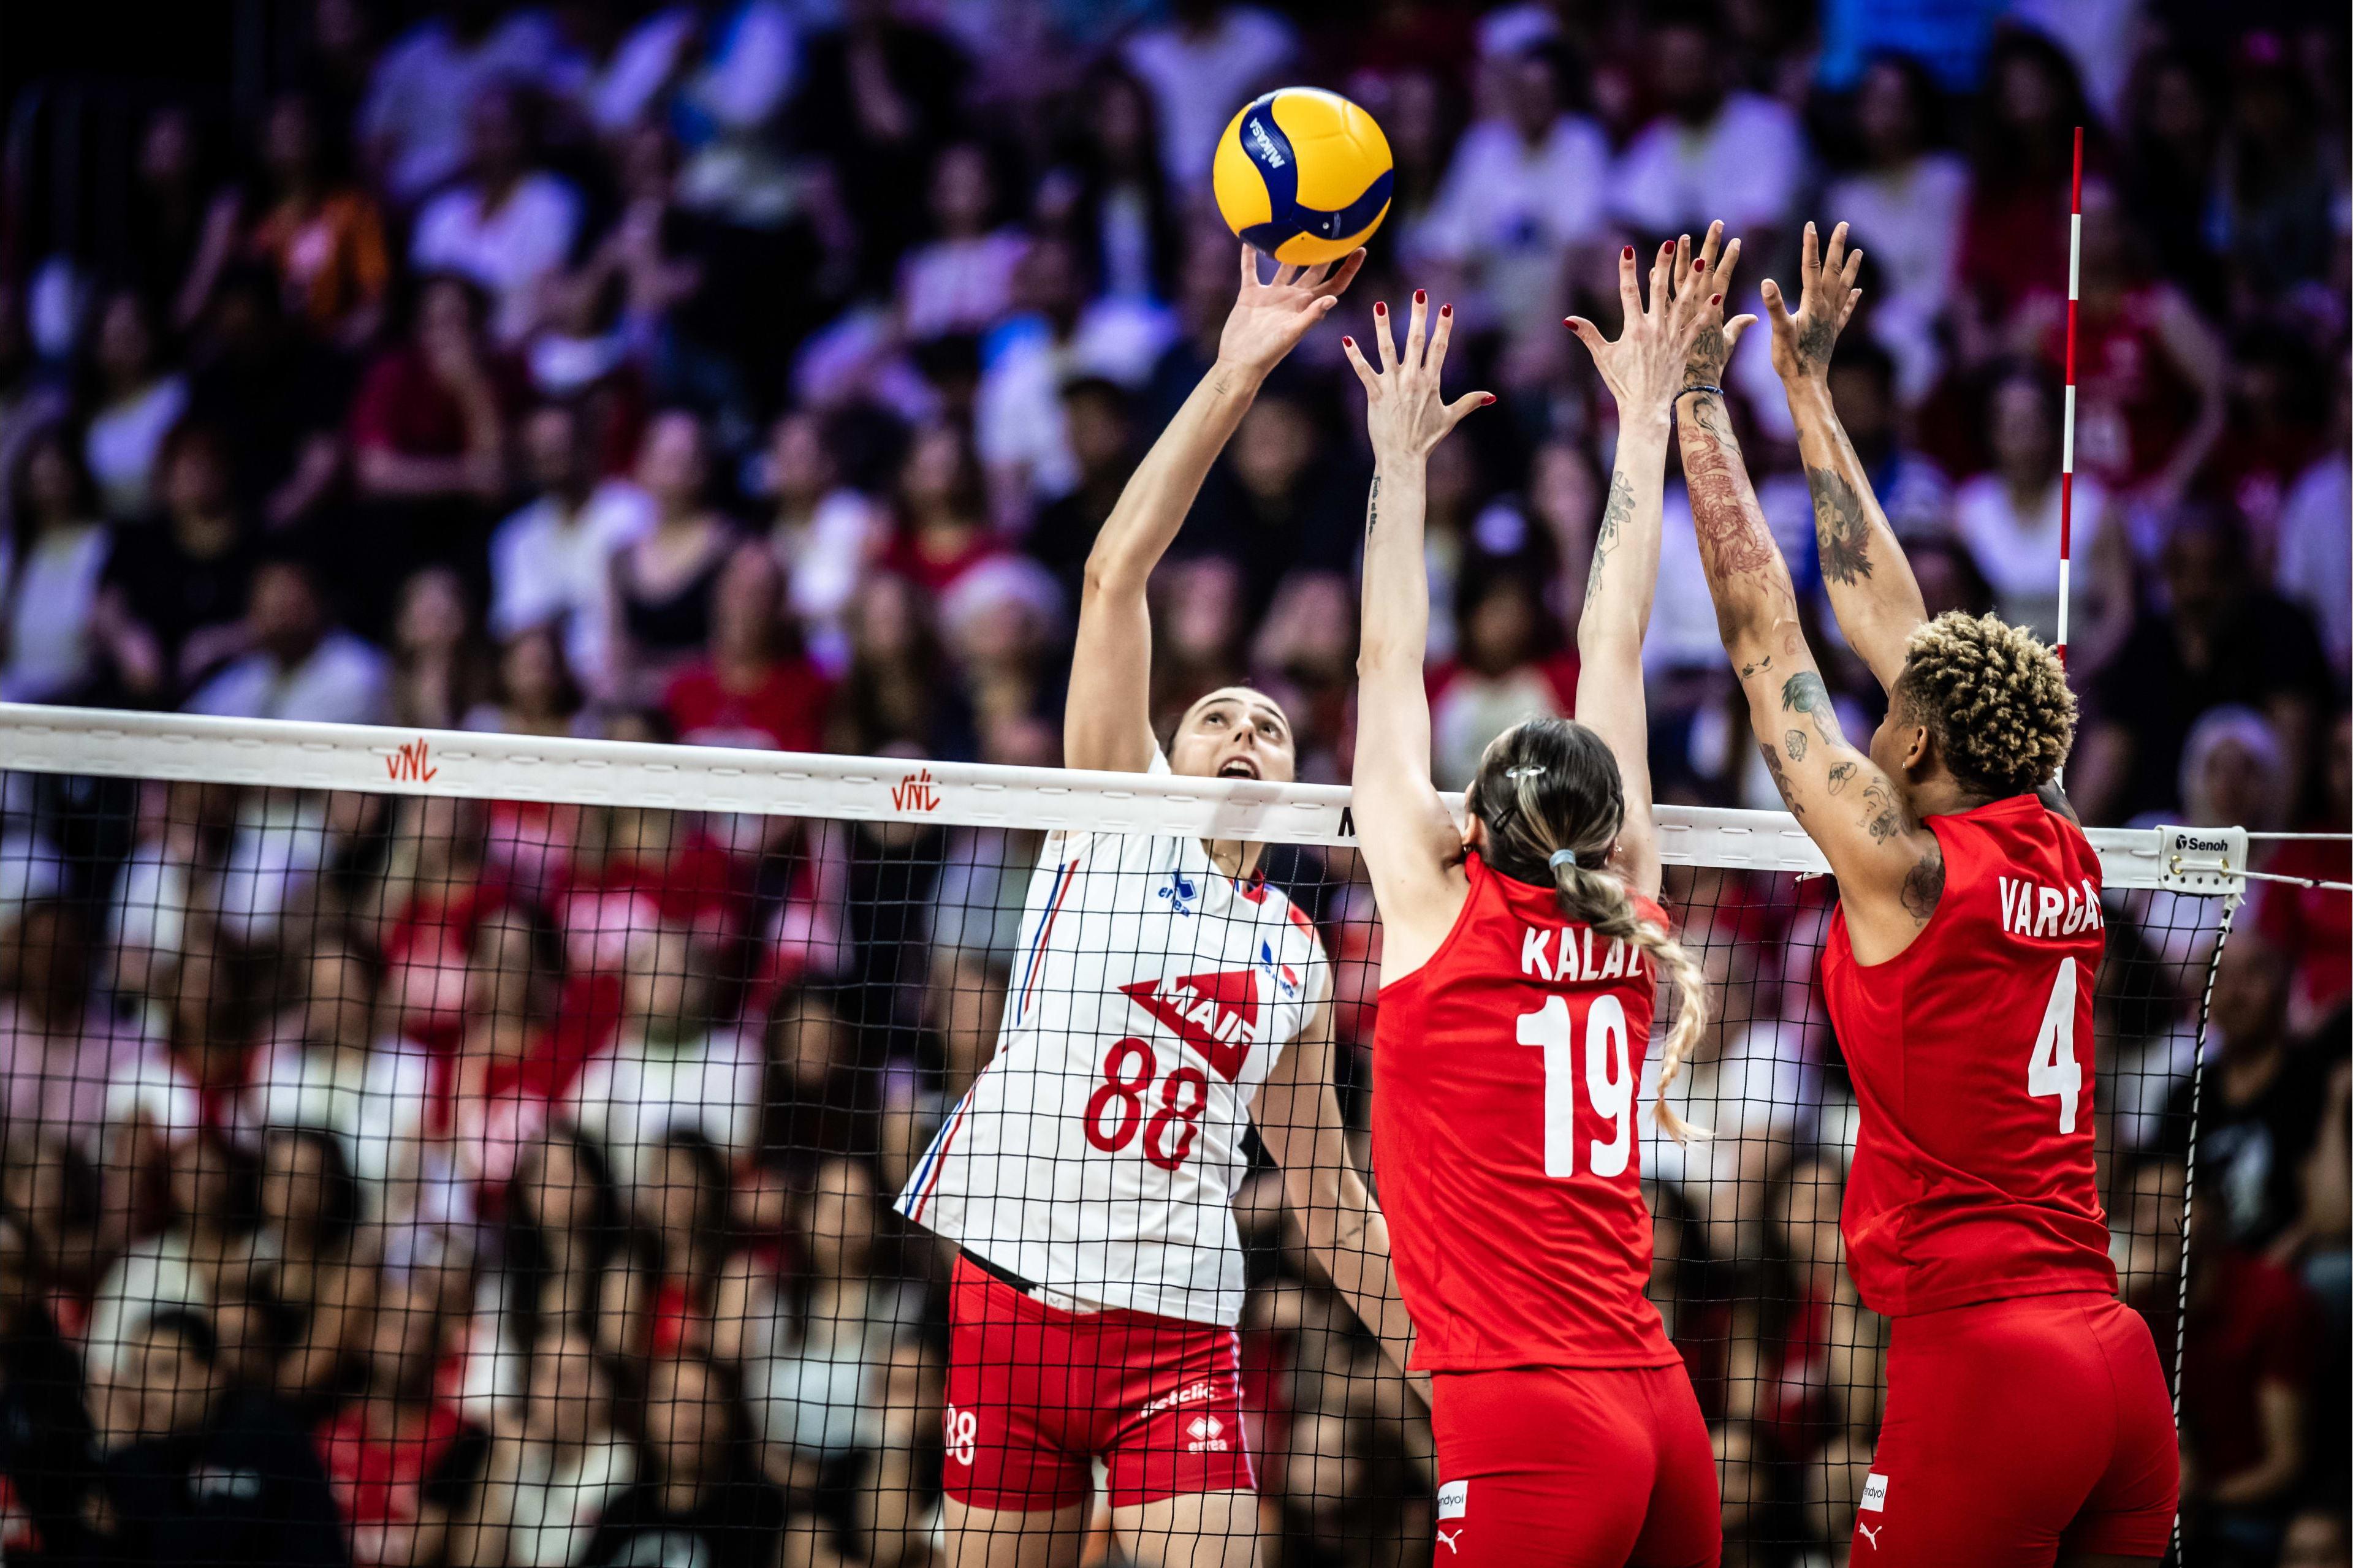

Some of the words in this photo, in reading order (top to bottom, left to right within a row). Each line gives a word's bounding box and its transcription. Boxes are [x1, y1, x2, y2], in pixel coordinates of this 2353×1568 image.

[1250, 117, 1285, 169] MIKASA
[2188, 837, 2229, 852] Senoh
[1158, 887, 1190, 918] erea
[1150, 979, 1256, 1049] MAIF
[2028, 956, 2081, 1135] 4
[1083, 1037, 1207, 1172] 88
[1516, 994, 1633, 1178] 19
[946, 1403, 977, 1466] 88
[1439, 1493, 1464, 1507] ndyol
